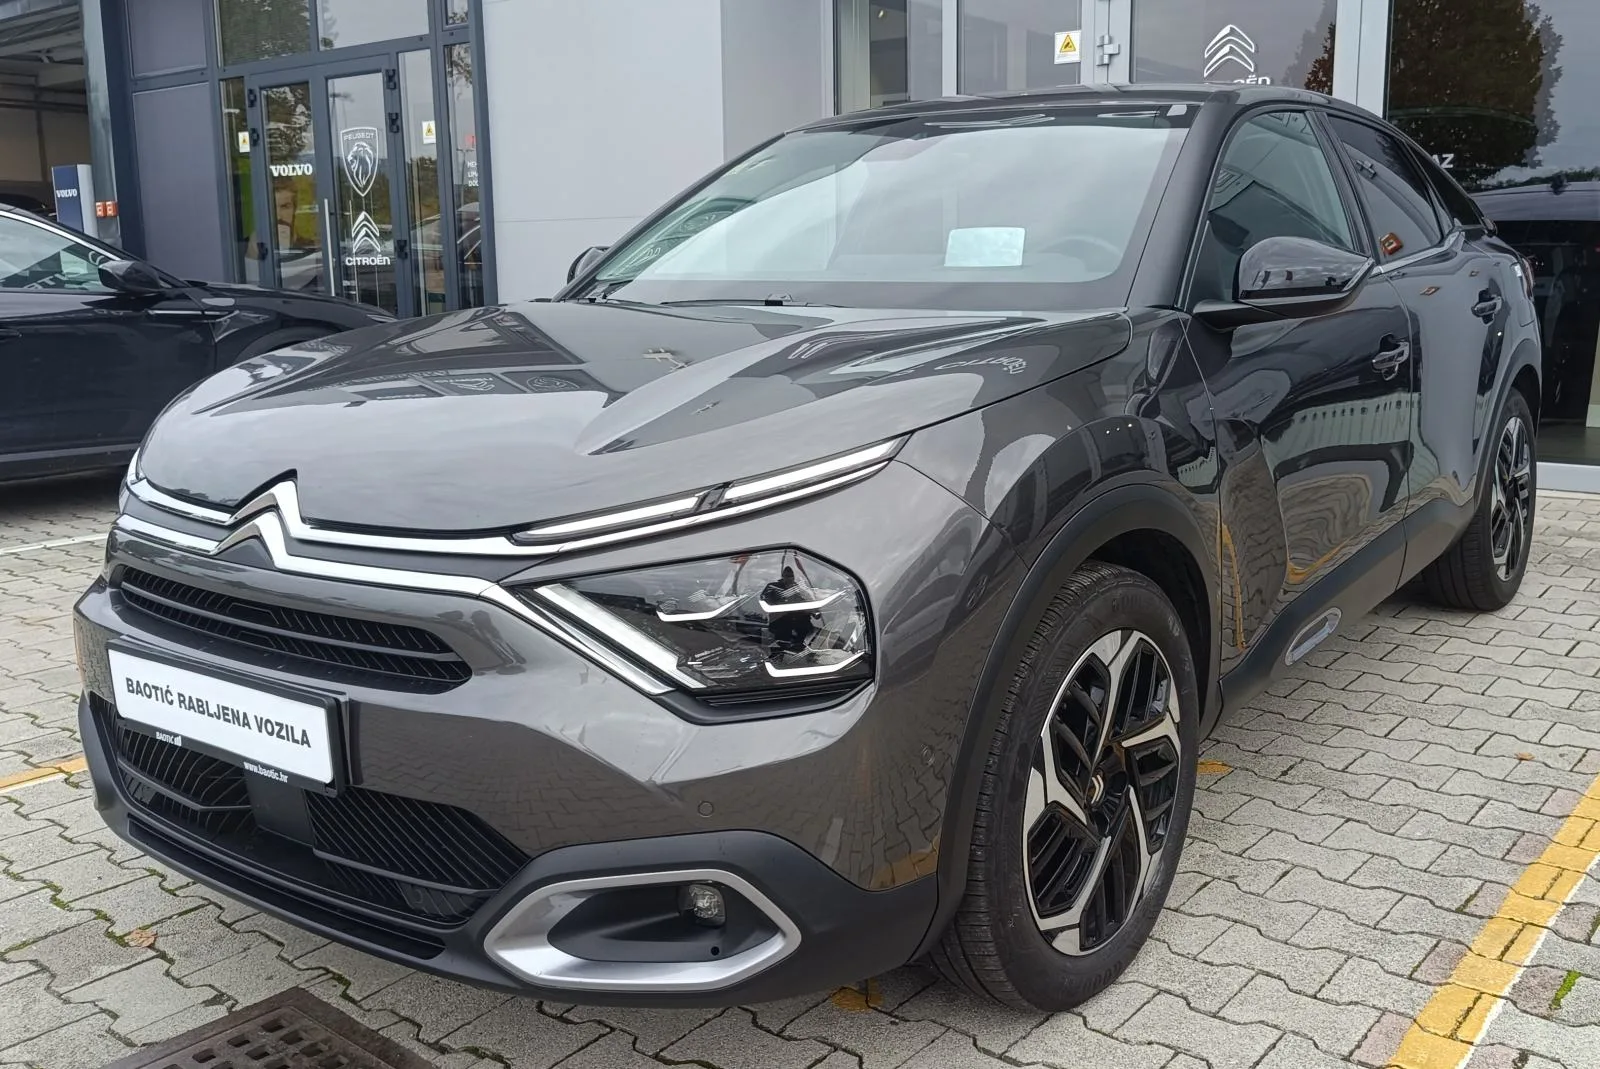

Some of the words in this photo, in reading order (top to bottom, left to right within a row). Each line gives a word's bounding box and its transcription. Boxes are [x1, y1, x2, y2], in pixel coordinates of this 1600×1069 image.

[343, 132, 374, 141] PEUGEOT
[269, 163, 313, 177] VOLVO
[55, 188, 78, 198] VOLVO
[125, 677, 174, 706] BAOTIĆ
[177, 692, 252, 731] RABLJENA
[253, 714, 312, 748] VOZILA
[243, 762, 288, 783] www.baotic.hr
